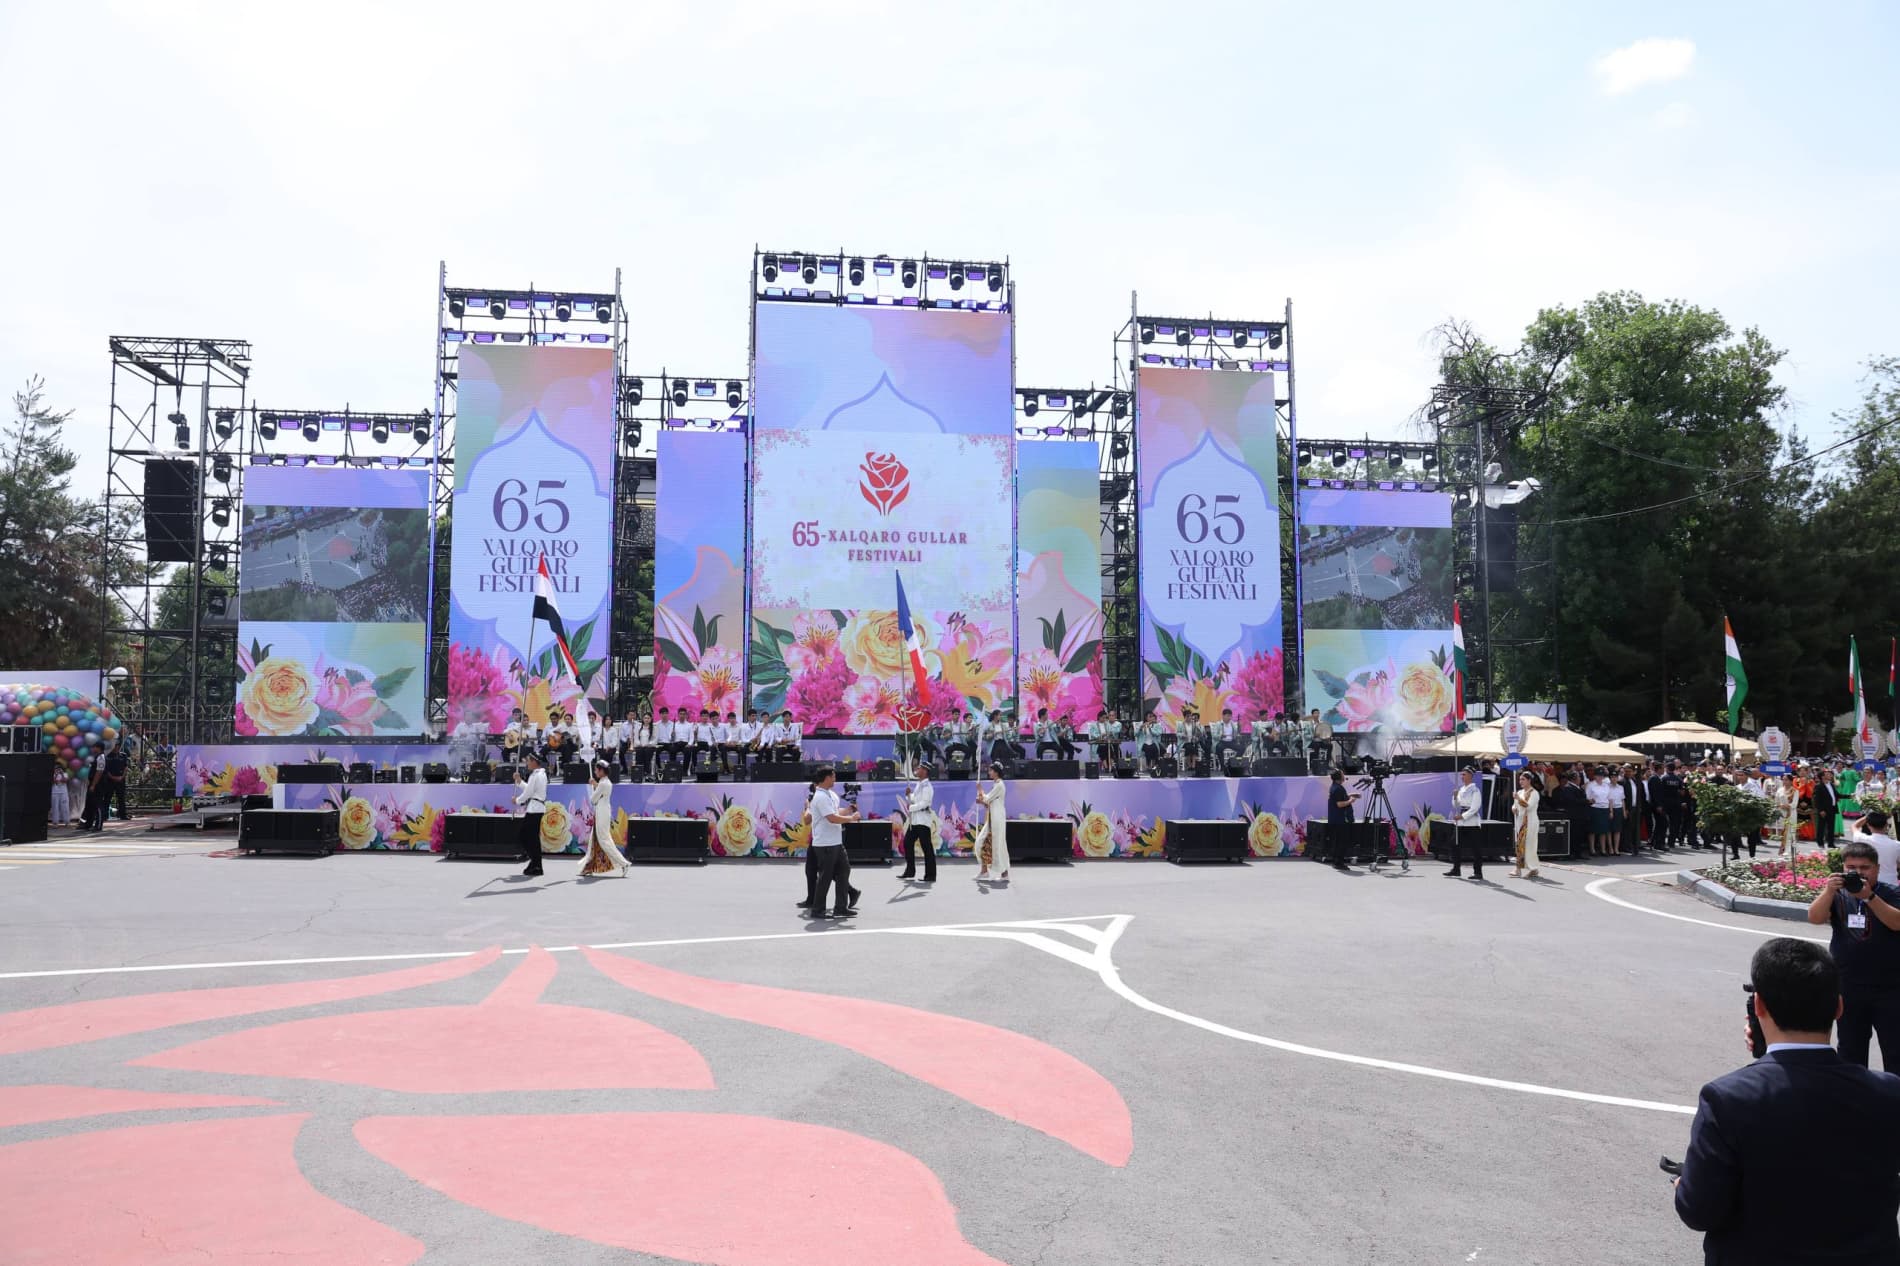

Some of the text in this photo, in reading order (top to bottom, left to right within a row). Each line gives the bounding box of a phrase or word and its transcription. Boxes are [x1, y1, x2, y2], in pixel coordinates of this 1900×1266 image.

[492, 478, 570, 534] 65
[1176, 493, 1245, 545] 65
[907, 531, 968, 545] GULLAR
[483, 539, 579, 558] XALQARO
[848, 549, 922, 562] FESTIVALI
[1170, 550, 1254, 567] XALQARO
[1178, 567, 1245, 583] GULLAR
[479, 575, 580, 593] FESTIALI
[1168, 583, 1256, 600] FESTIVALI
